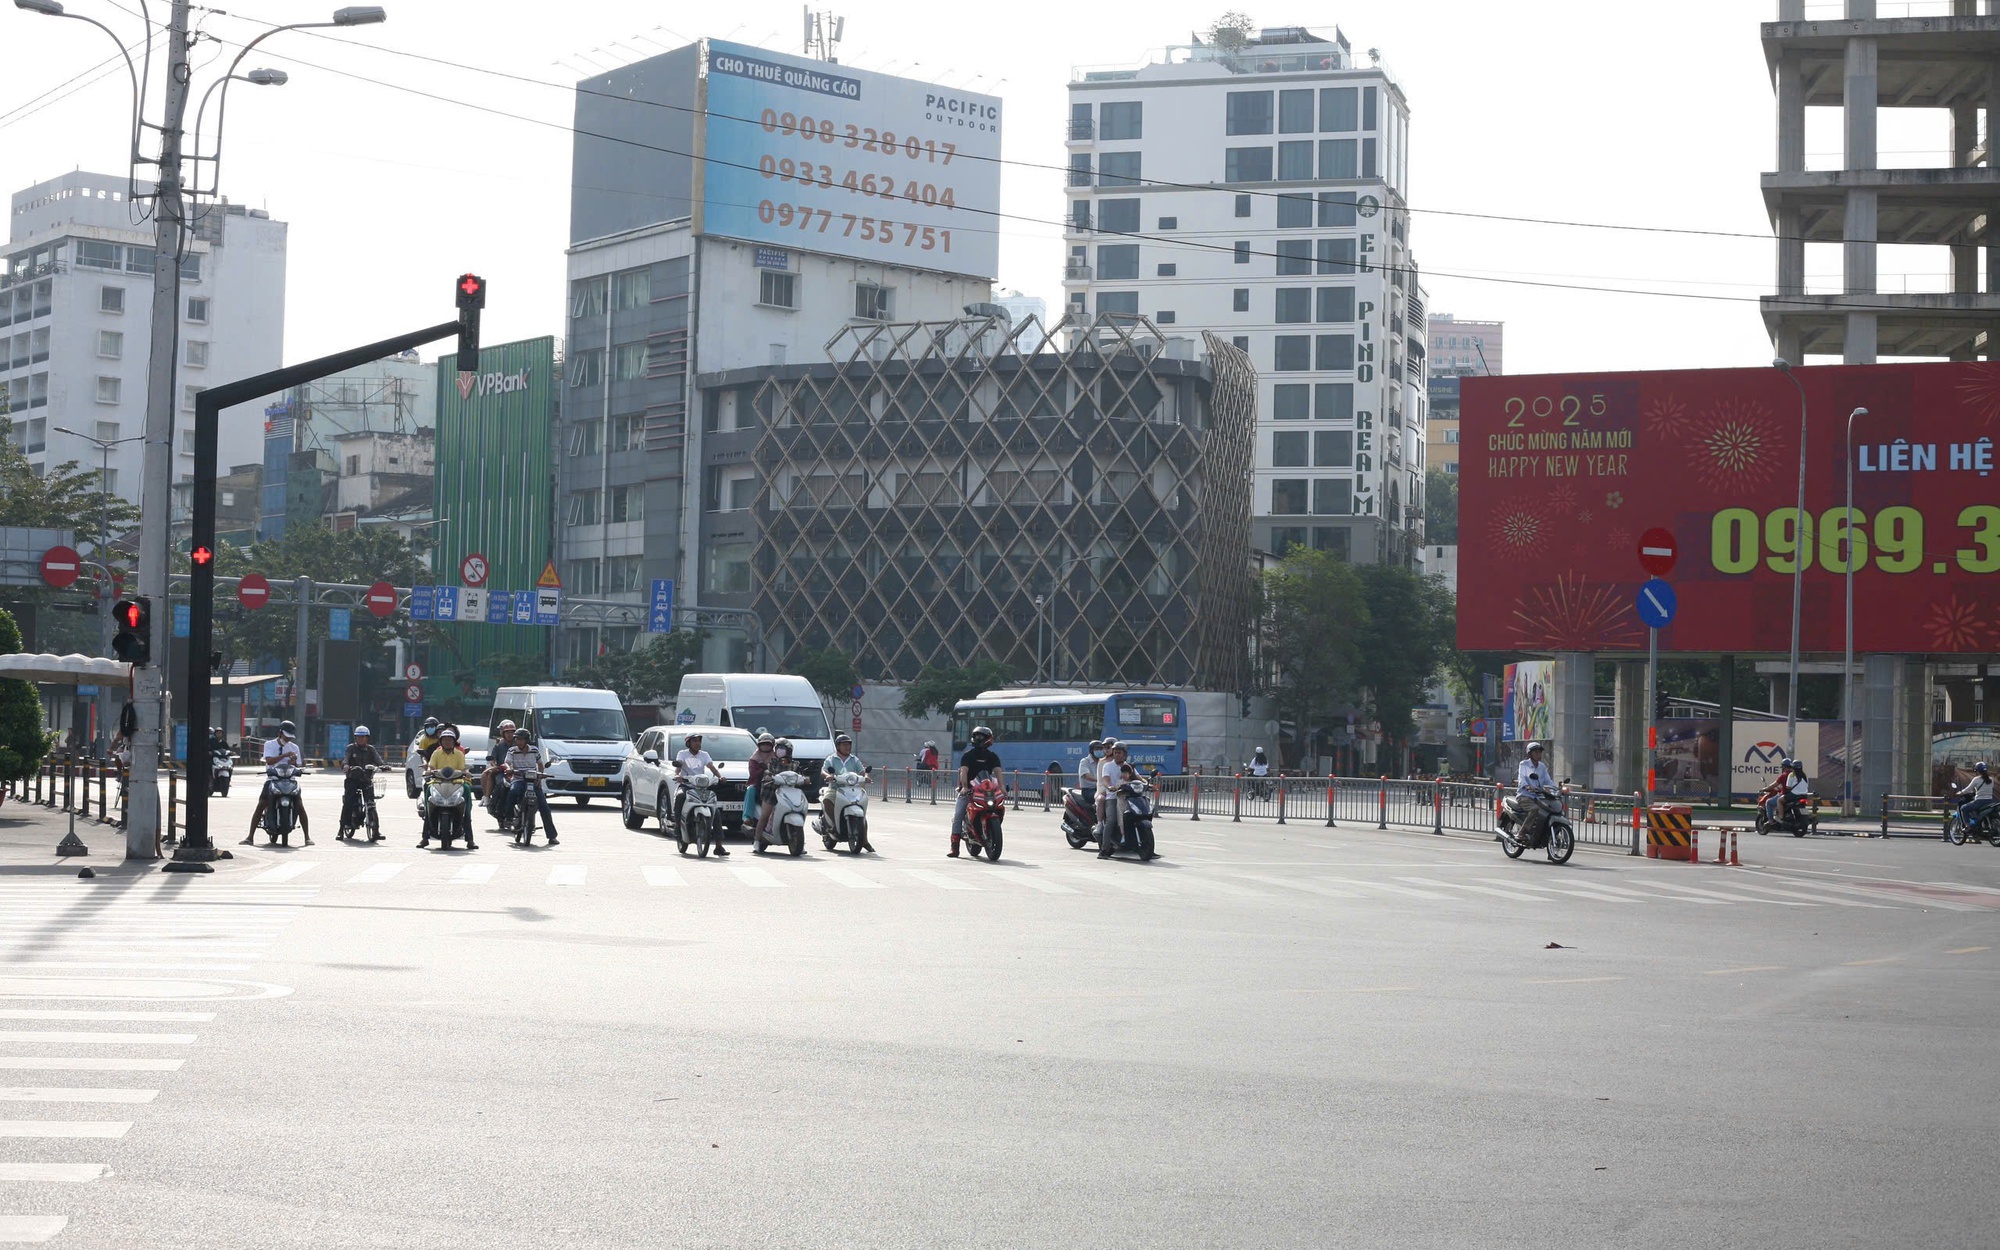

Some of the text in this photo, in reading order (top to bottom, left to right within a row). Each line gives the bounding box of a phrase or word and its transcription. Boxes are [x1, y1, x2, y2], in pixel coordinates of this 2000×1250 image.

[716, 56, 858, 97] CHO THUÊ QUẢNG CÁO
[925, 94, 997, 120] PACIFIC
[925, 112, 997, 133] OUTDOOR
[761, 108, 957, 166] 0908 328 017
[759, 154, 955, 210] 0933 462 404
[758, 199, 951, 253] 0977 755 751
[758, 248, 785, 257] PACIFIC
[477, 367, 531, 397] VPBank
[1353, 233, 1374, 514] EL PINO REALM
[1505, 394, 1607, 427] 2025
[1488, 427, 1632, 451] CHÚC MỪNG NĂM MỚI
[1488, 454, 1628, 478] HAPPY NEW YEAR
[1859, 437, 1994, 476] LIÊN HỆ
[1711, 505, 2000, 575] 0969.3
[1731, 765, 1782, 774] HCMC ME
